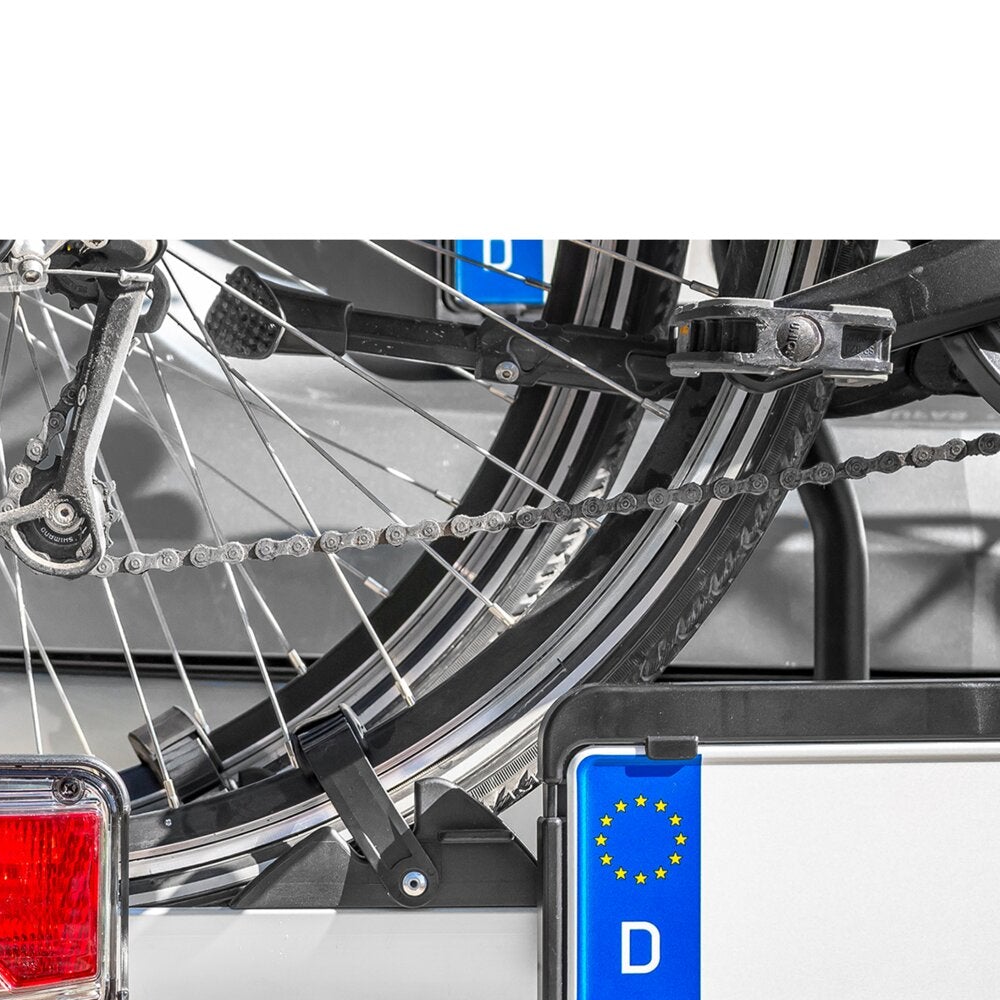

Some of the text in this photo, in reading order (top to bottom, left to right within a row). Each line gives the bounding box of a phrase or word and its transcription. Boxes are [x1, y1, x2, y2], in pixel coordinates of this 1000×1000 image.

[483, 240, 512, 271] D
[40, 526, 74, 543] SHIMANO
[621, 921, 660, 974] D
